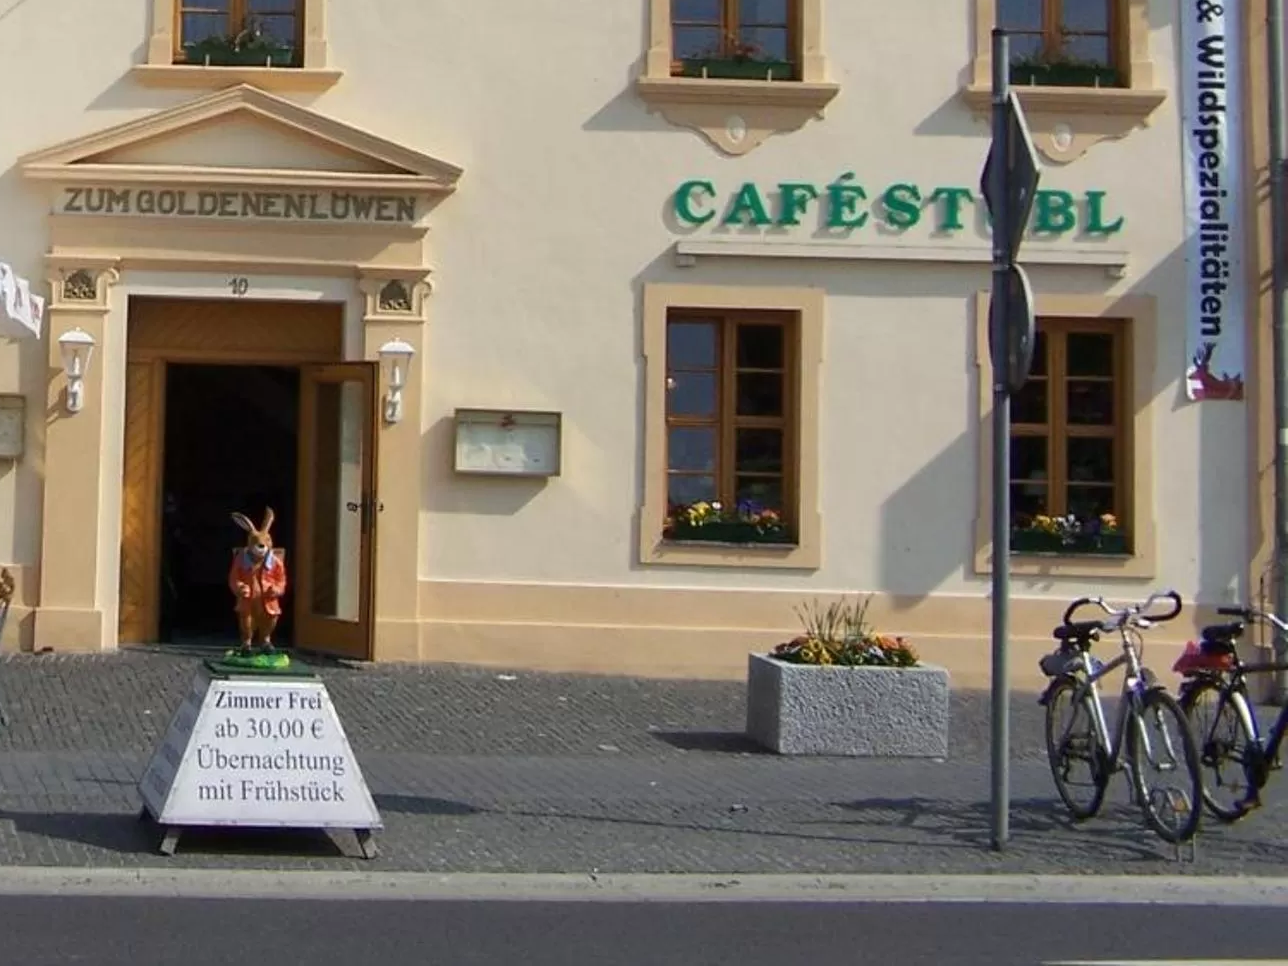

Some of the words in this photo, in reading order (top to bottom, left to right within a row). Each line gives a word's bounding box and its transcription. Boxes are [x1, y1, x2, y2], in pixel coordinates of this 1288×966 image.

[1192, 35, 1229, 337] Wildspezialitäten
[63, 187, 131, 212] ZUM
[135, 189, 306, 219] GOLDENEN
[674, 170, 1125, 234] CAFÉSTBL
[228, 277, 249, 295] 10
[214, 690, 283, 711] Zimmer
[288, 690, 323, 711] Frei
[215, 718, 240, 740] ab
[245, 718, 305, 743] 30,00
[310, 718, 325, 740] €
[196, 744, 346, 777] Übernachtung
[198, 779, 234, 802] mit
[241, 780, 346, 803] Frühstück
